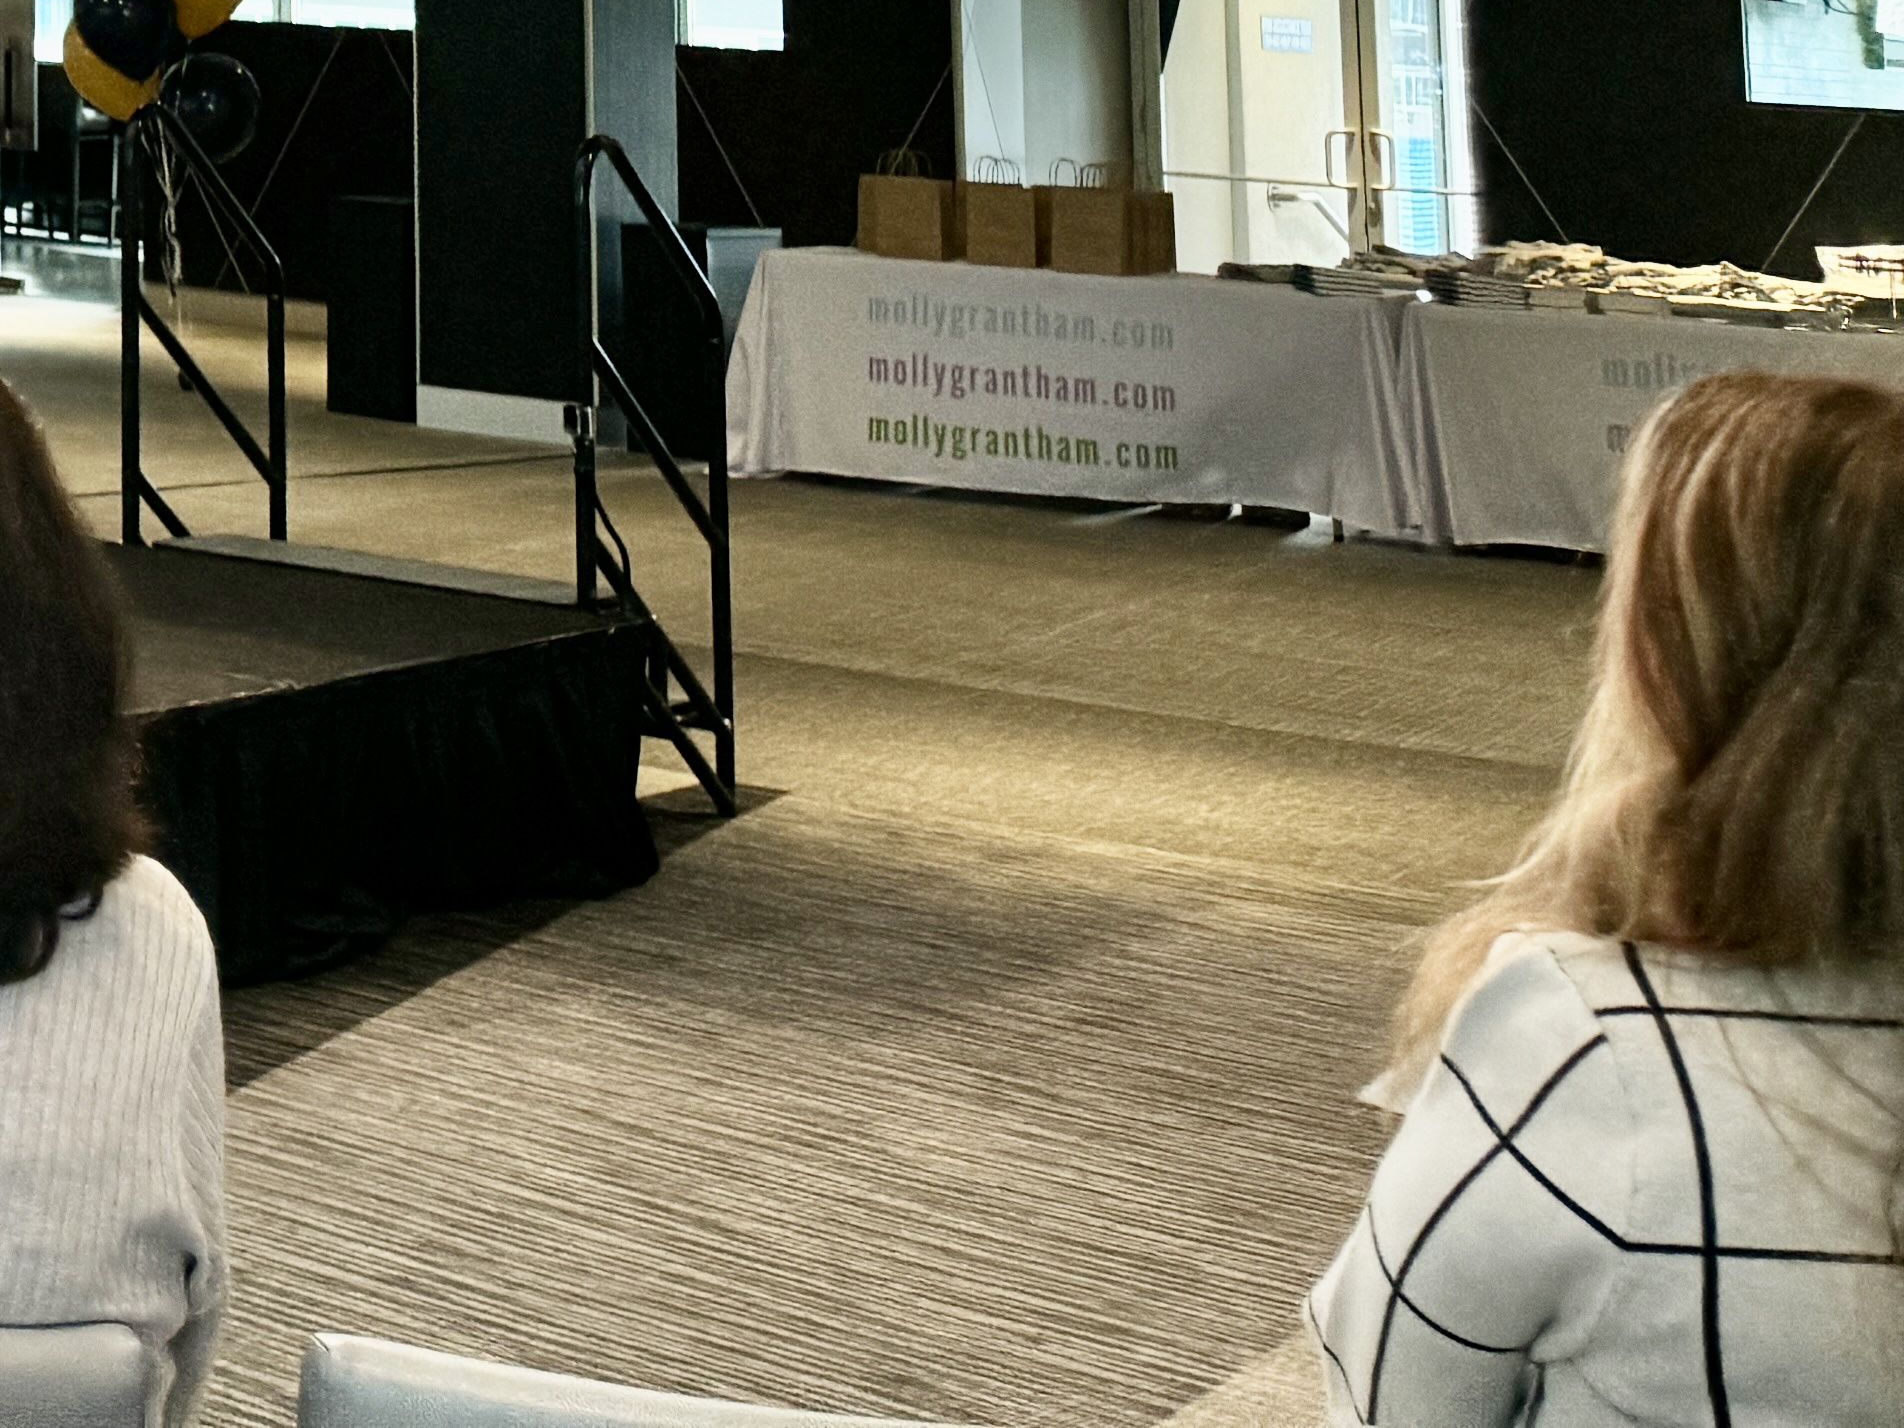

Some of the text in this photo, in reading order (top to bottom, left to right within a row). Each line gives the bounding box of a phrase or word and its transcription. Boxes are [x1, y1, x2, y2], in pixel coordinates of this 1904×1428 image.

[868, 293, 1175, 350] mollygrantham.com
[868, 352, 1177, 412] mollygrantham.com
[868, 414, 1179, 471] mollygrantham.com
